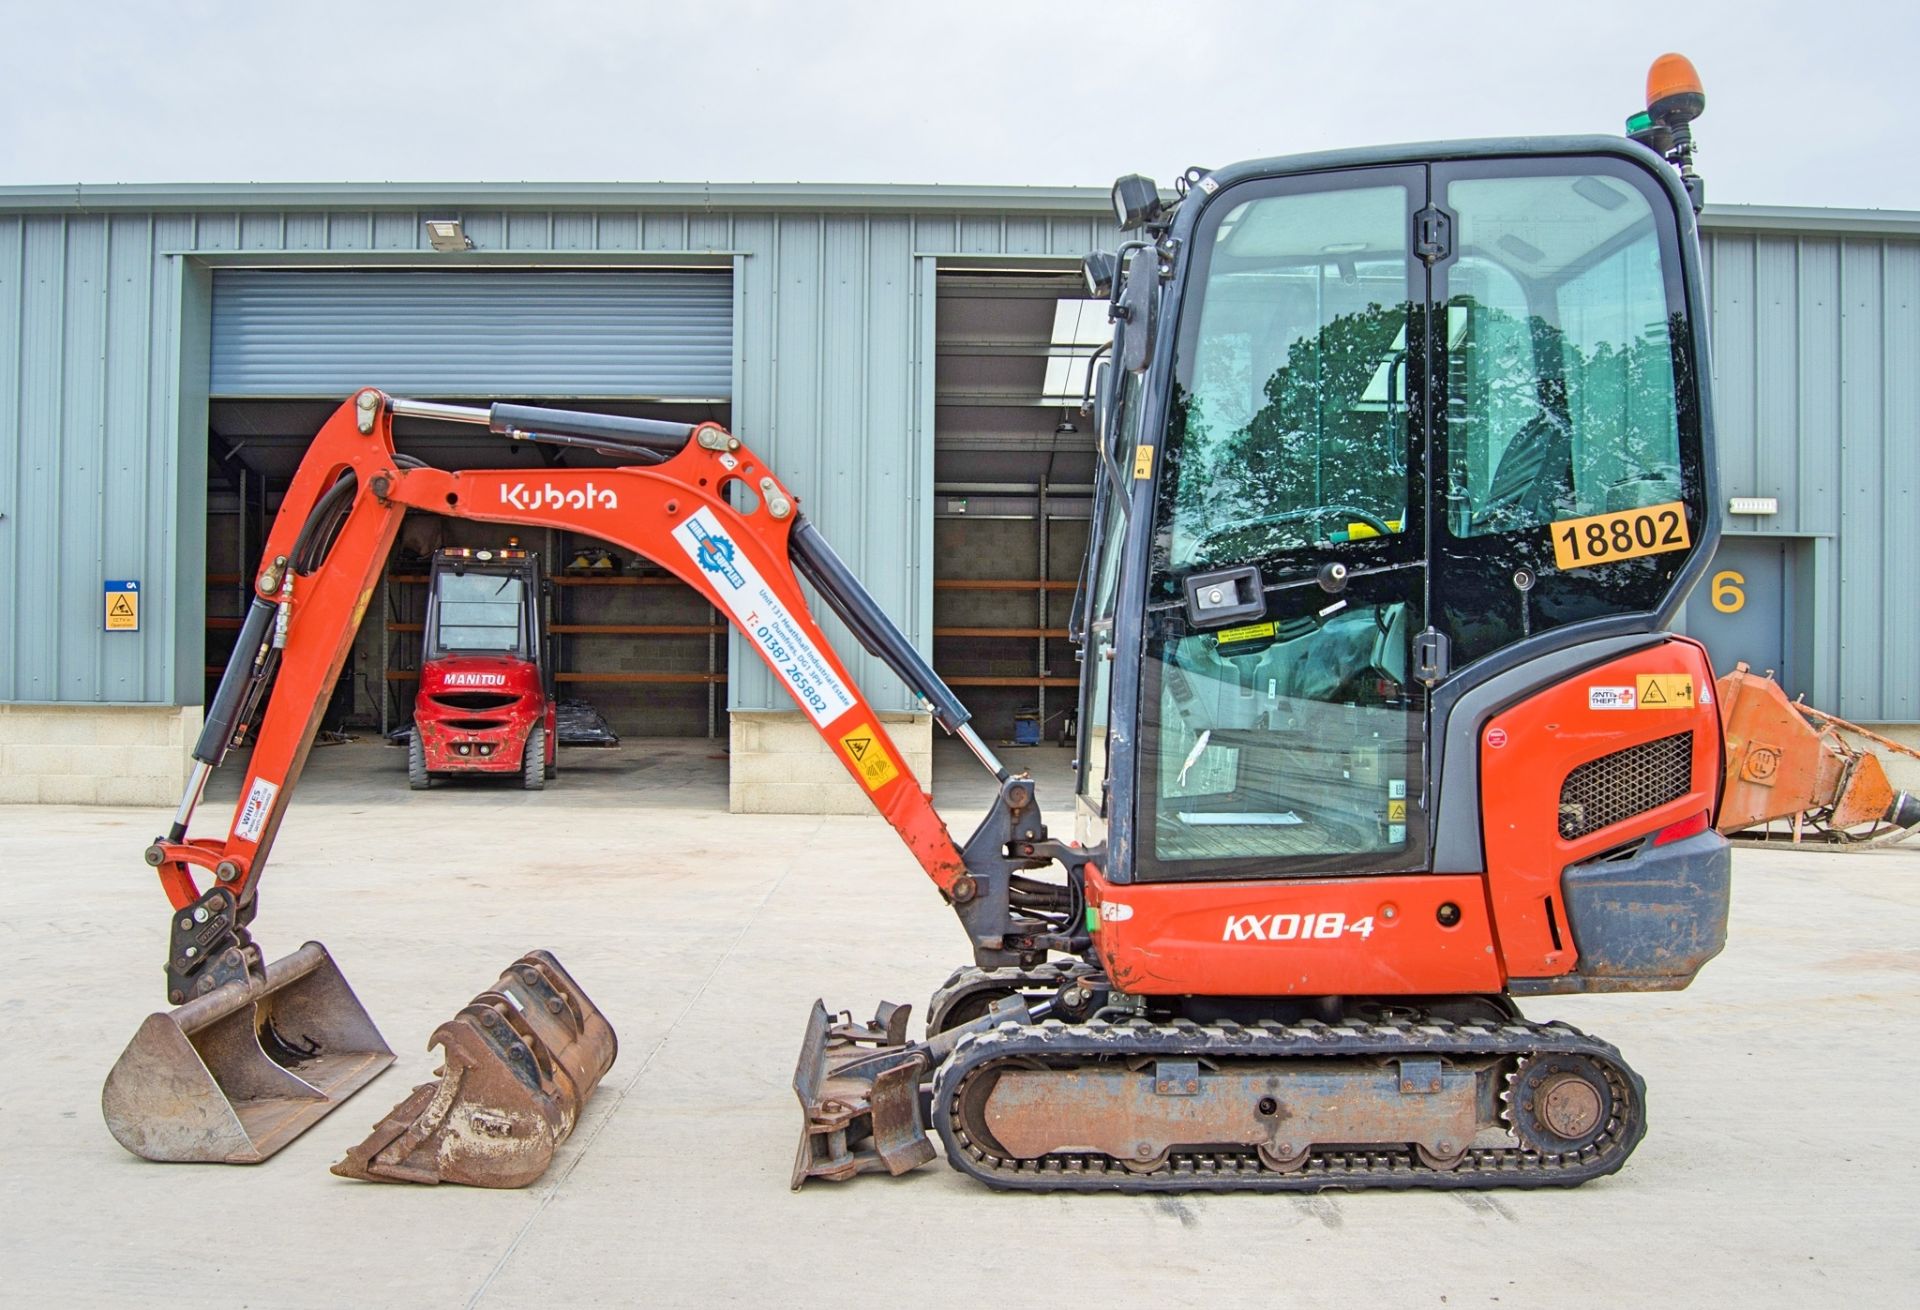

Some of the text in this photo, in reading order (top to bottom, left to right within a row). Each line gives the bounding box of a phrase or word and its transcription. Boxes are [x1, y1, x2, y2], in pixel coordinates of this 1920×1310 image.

[501, 482, 617, 510] Kubota
[1562, 511, 1683, 560] 18802
[713, 551, 744, 589] SUPPLIES
[1711, 570, 1745, 613] 6
[747, 610, 827, 714] T: 01387 265882
[759, 589, 850, 706] Unit 131 Heathhall Industrial Estate
[444, 673, 506, 686] MANITOU
[241, 790, 261, 825] WHITES
[1222, 912, 1375, 941] KX018-4
